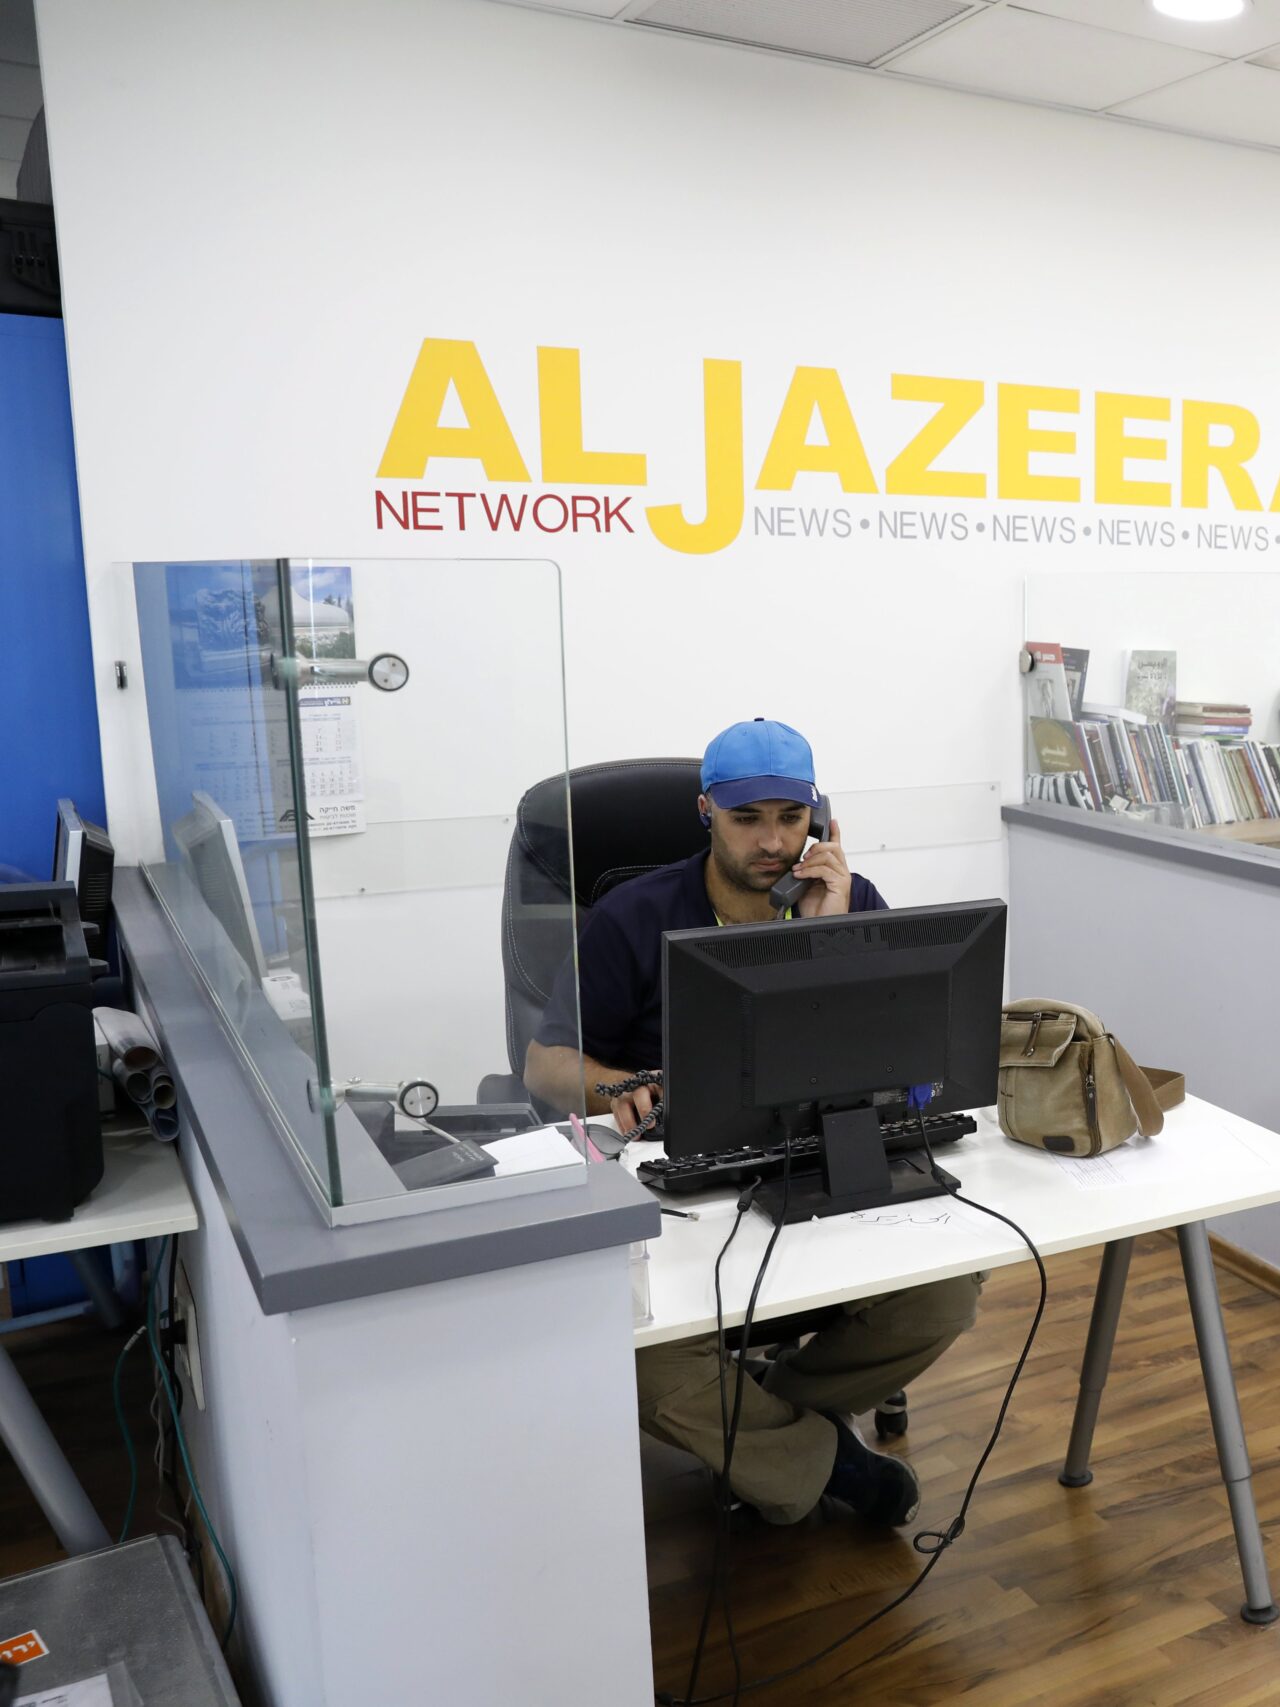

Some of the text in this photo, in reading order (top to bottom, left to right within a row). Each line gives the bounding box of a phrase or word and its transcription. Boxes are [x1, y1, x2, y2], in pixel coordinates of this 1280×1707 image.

[376, 337, 647, 486] AL
[374, 490, 635, 534] NETWORK
[754, 506, 852, 538] NEWS
[879, 510, 968, 541] NEWS
[993, 514, 1076, 544] NEWS
[1099, 519, 1175, 547] NEWS
[1197, 523, 1269, 551] NEWS
